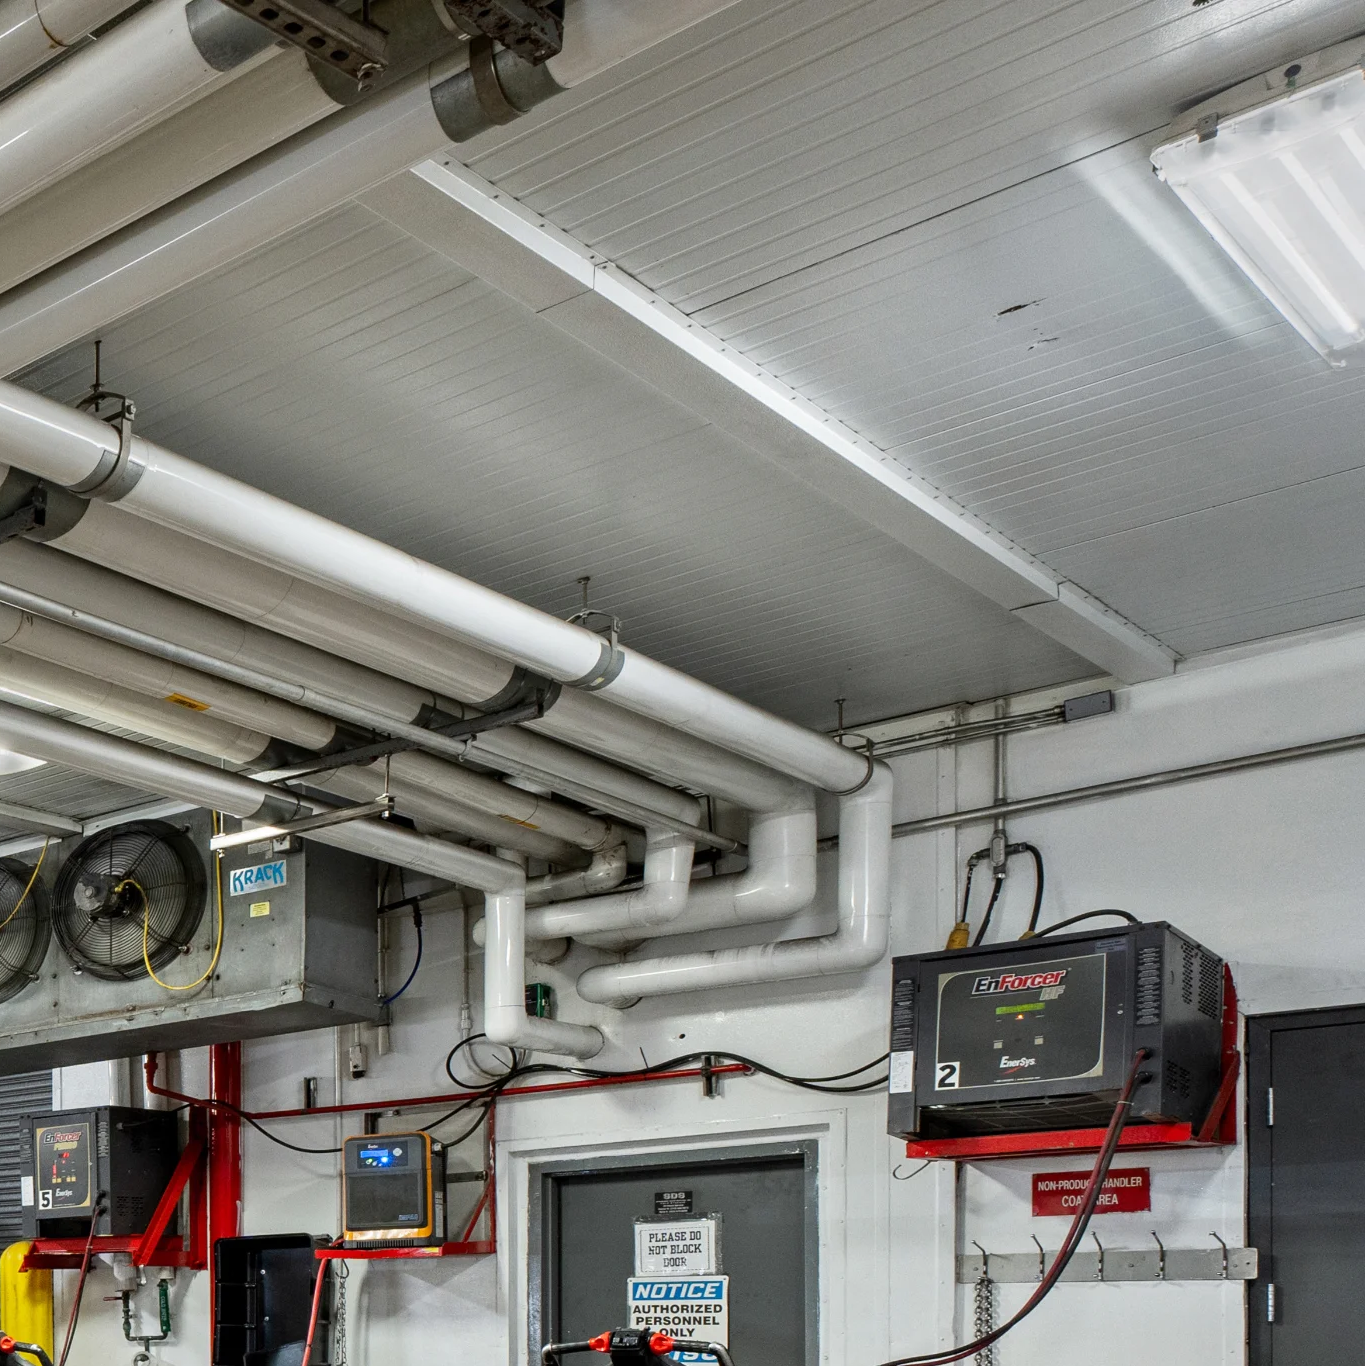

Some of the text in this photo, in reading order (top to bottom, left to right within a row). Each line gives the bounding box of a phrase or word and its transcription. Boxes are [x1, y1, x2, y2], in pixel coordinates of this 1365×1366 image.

[232, 861, 284, 893] KRACK
[972, 969, 1067, 995] EnForcer
[1040, 985, 1066, 1001] HF
[999, 1055, 1035, 1069] EnerSys
[937, 1064, 957, 1088] 2
[43, 1131, 82, 1144] EnForcer
[41, 1192, 51, 1208] 5
[648, 1230, 702, 1243] PLEASE DO
[648, 1243, 702, 1255] NOT BLOCK
[663, 1257, 687, 1267] DOOR
[635, 1282, 721, 1299] NOTICE
[633, 1304, 722, 1314] AUTHORIZED
[635, 1316, 720, 1326] PERSONNEL
[659, 1328, 695, 1338] ONLY
